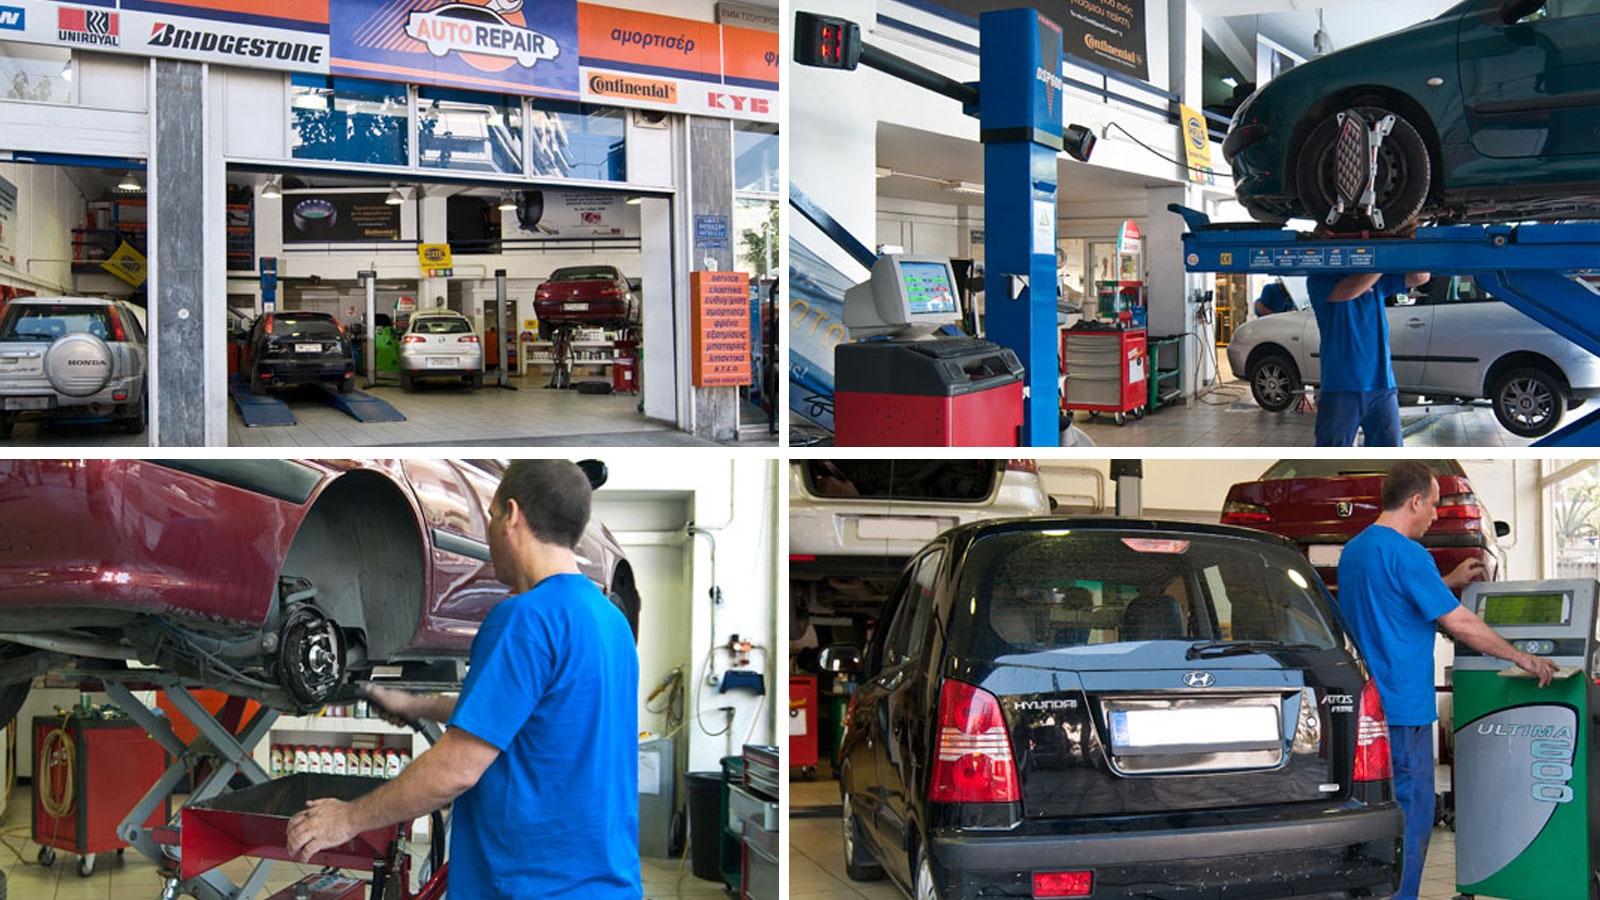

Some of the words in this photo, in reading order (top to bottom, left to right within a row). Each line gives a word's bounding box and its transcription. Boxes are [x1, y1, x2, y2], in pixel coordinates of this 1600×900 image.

[58, 30, 119, 46] UNIROYAL
[147, 22, 323, 64] BRIDGESTONE
[417, 18, 473, 44] AUTO
[476, 26, 545, 53] REPAIR
[611, 28, 695, 54] αμορτισέρ
[1084, 33, 1136, 63] Continental
[589, 75, 670, 99] Continental
[708, 92, 769, 114] KYB
[1013, 699, 1078, 710] HYUNDAI
[1477, 723, 1572, 739] ULTIMA
[1530, 739, 1574, 803] 600
